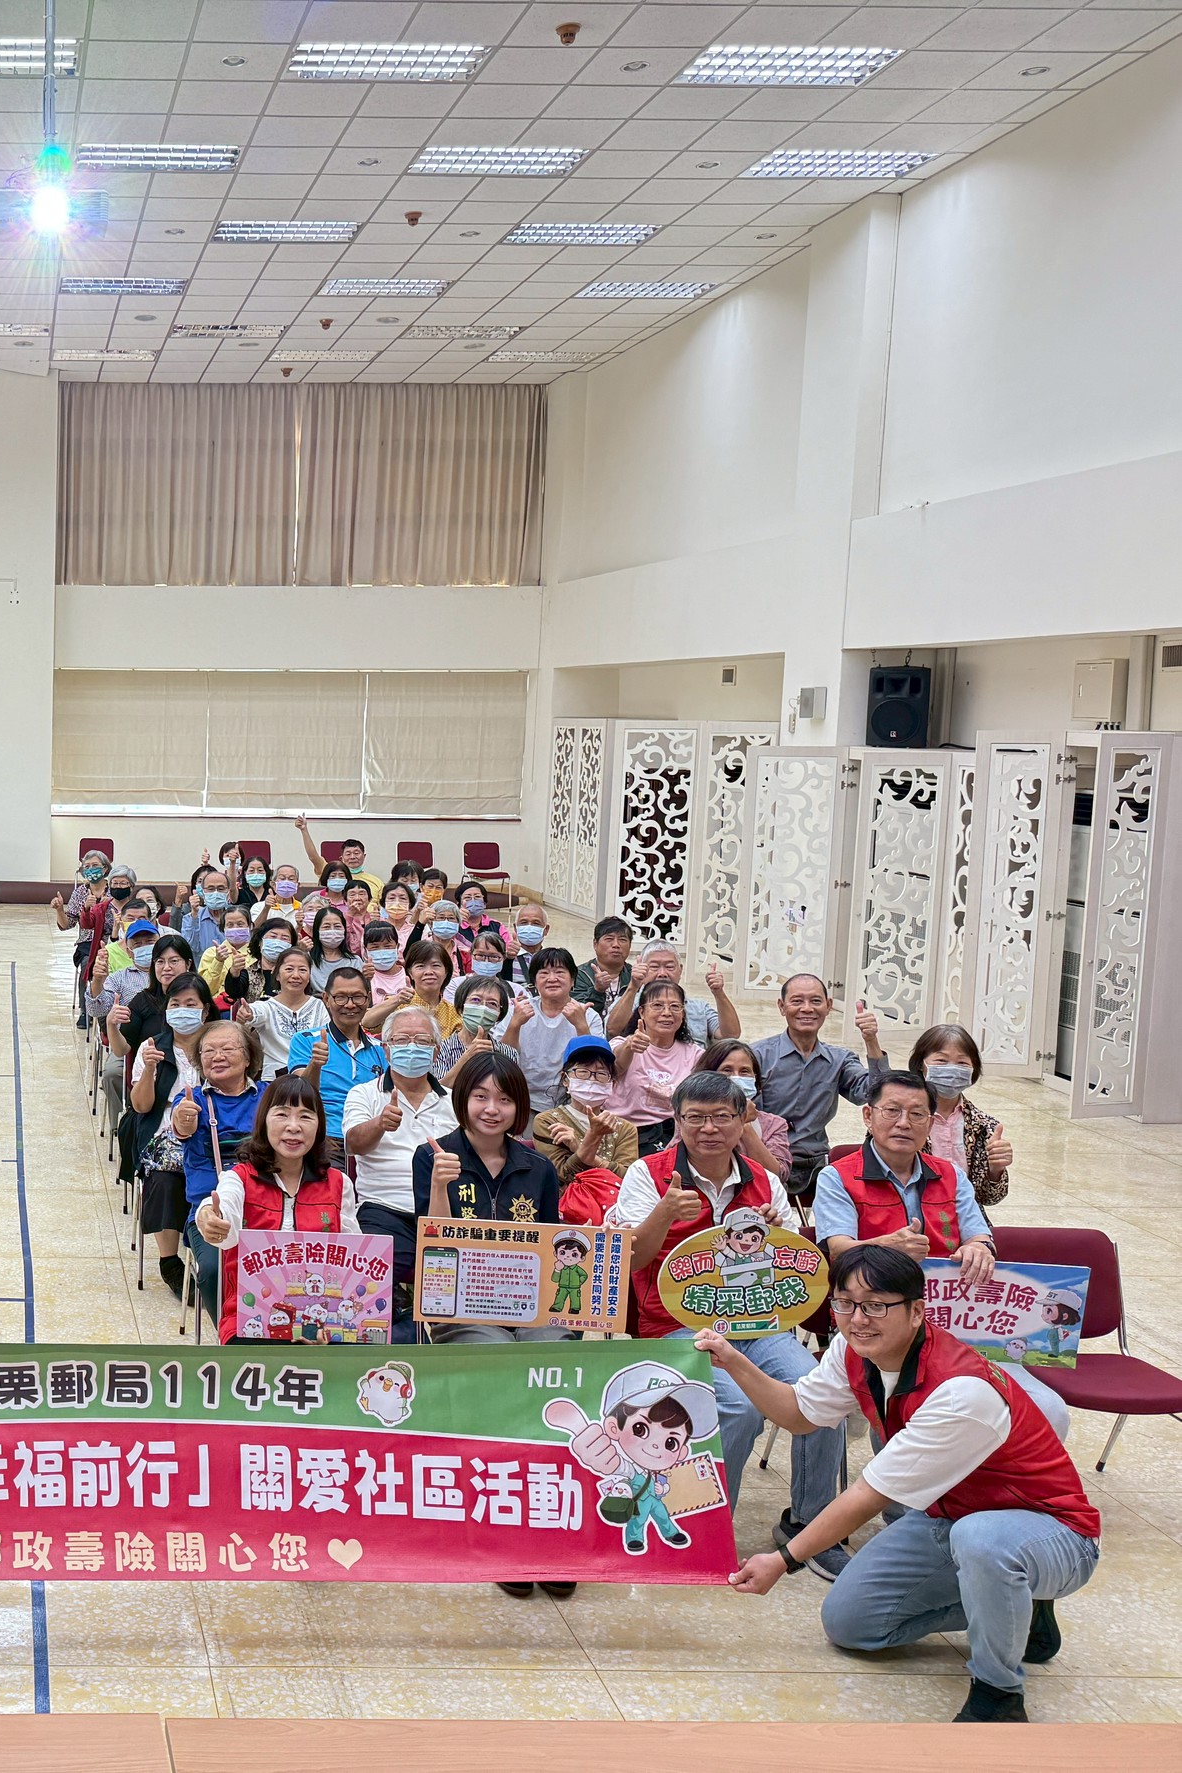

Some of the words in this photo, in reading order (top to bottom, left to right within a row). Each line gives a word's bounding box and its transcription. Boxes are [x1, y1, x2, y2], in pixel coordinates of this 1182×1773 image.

[442, 1226, 539, 1243] 防詐騙重要提醒
[744, 1213, 760, 1222] POST
[242, 1242, 389, 1281] 郵政壽險關心您
[591, 1232, 605, 1316] 需要您的共同努力
[607, 1233, 622, 1317] 保障您的財產安全
[670, 1251, 714, 1280] 樂而
[773, 1247, 820, 1273] 忘齡
[683, 1277, 809, 1314] 精采郵我
[923, 1277, 1038, 1312] 郵政壽險
[924, 1306, 1019, 1335] 關心您
[528, 1366, 583, 1389] NO.1
